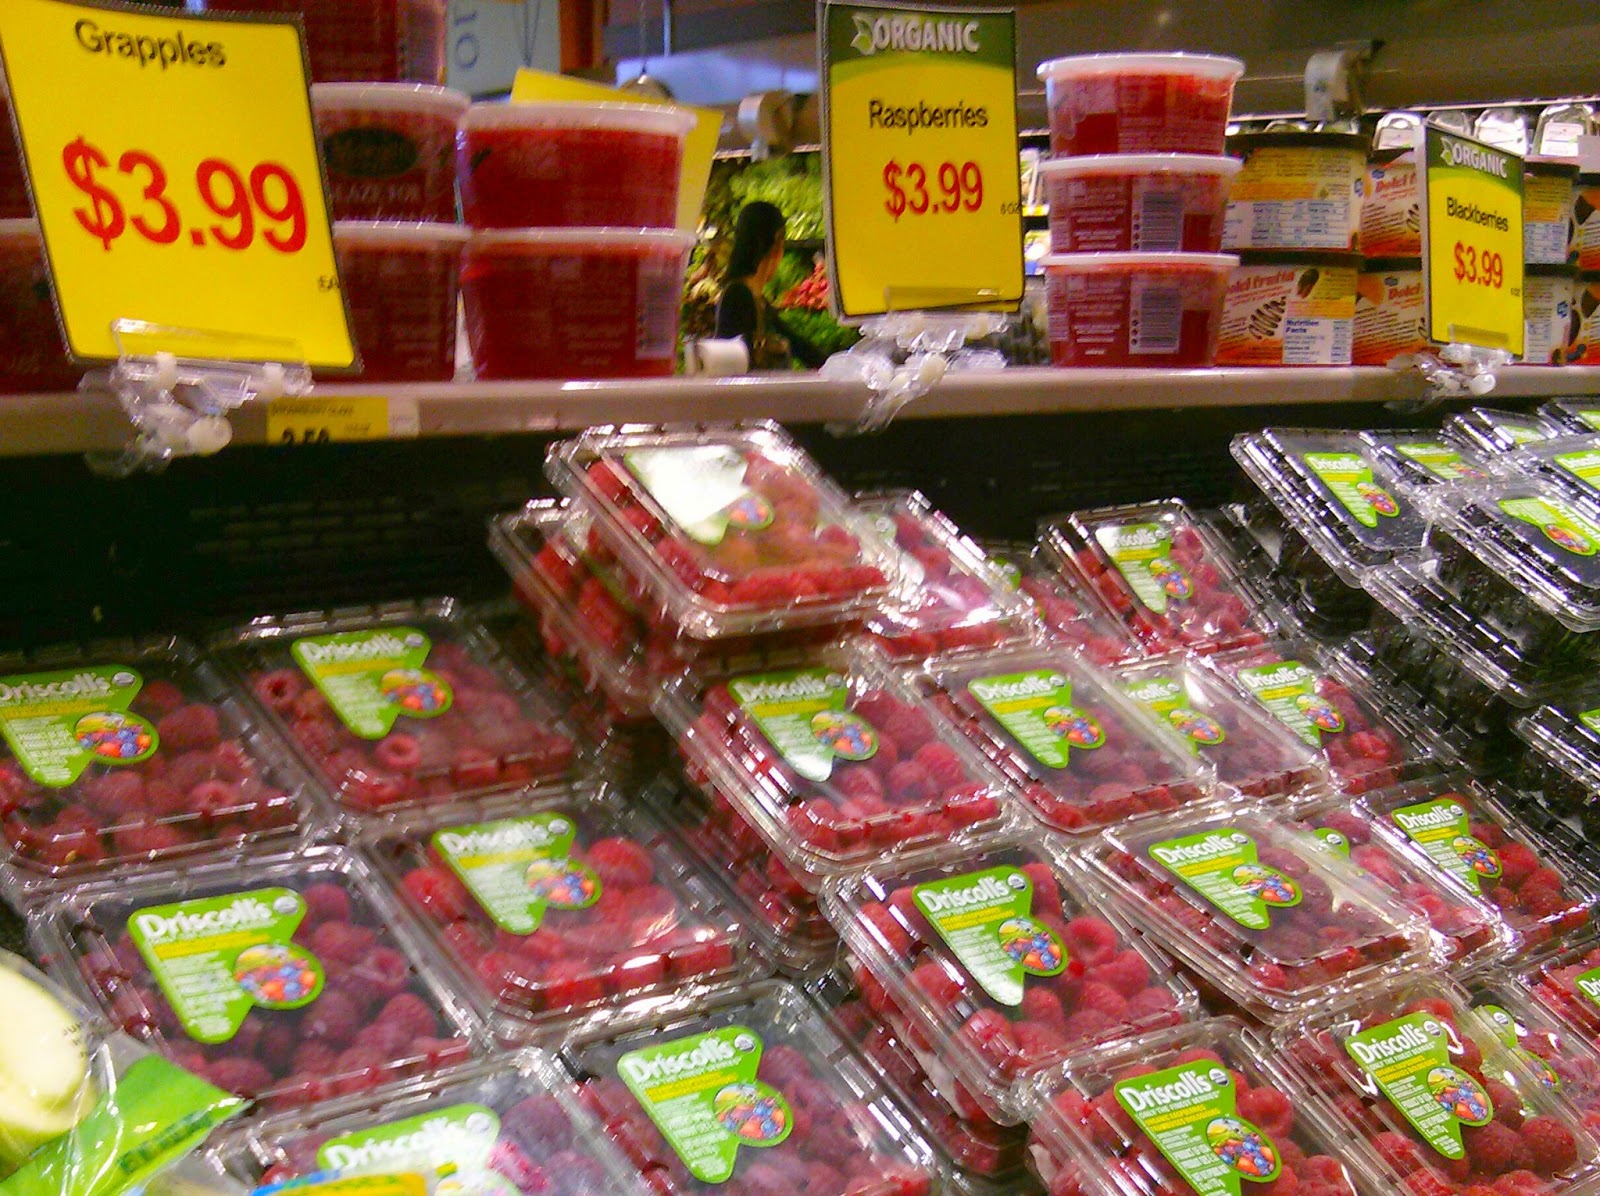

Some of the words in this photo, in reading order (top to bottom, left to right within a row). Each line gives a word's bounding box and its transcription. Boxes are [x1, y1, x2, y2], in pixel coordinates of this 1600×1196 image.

[74, 18, 227, 70] Grapples
[872, 17, 980, 53] ORGANIC
[869, 99, 988, 134] Raspberries
[1453, 145, 1509, 179] ORGANIC
[62, 135, 308, 254] $3.99
[883, 158, 984, 223] $3.99
[1446, 196, 1510, 232] Blackberries
[1453, 240, 1504, 289] $3.99
[1152, 834, 1236, 864] Driscoll's
[917, 875, 1010, 913] Driscoll's
[1349, 1023, 1428, 1065] Driscoll's
[1118, 1070, 1213, 1112] Driscoll's
